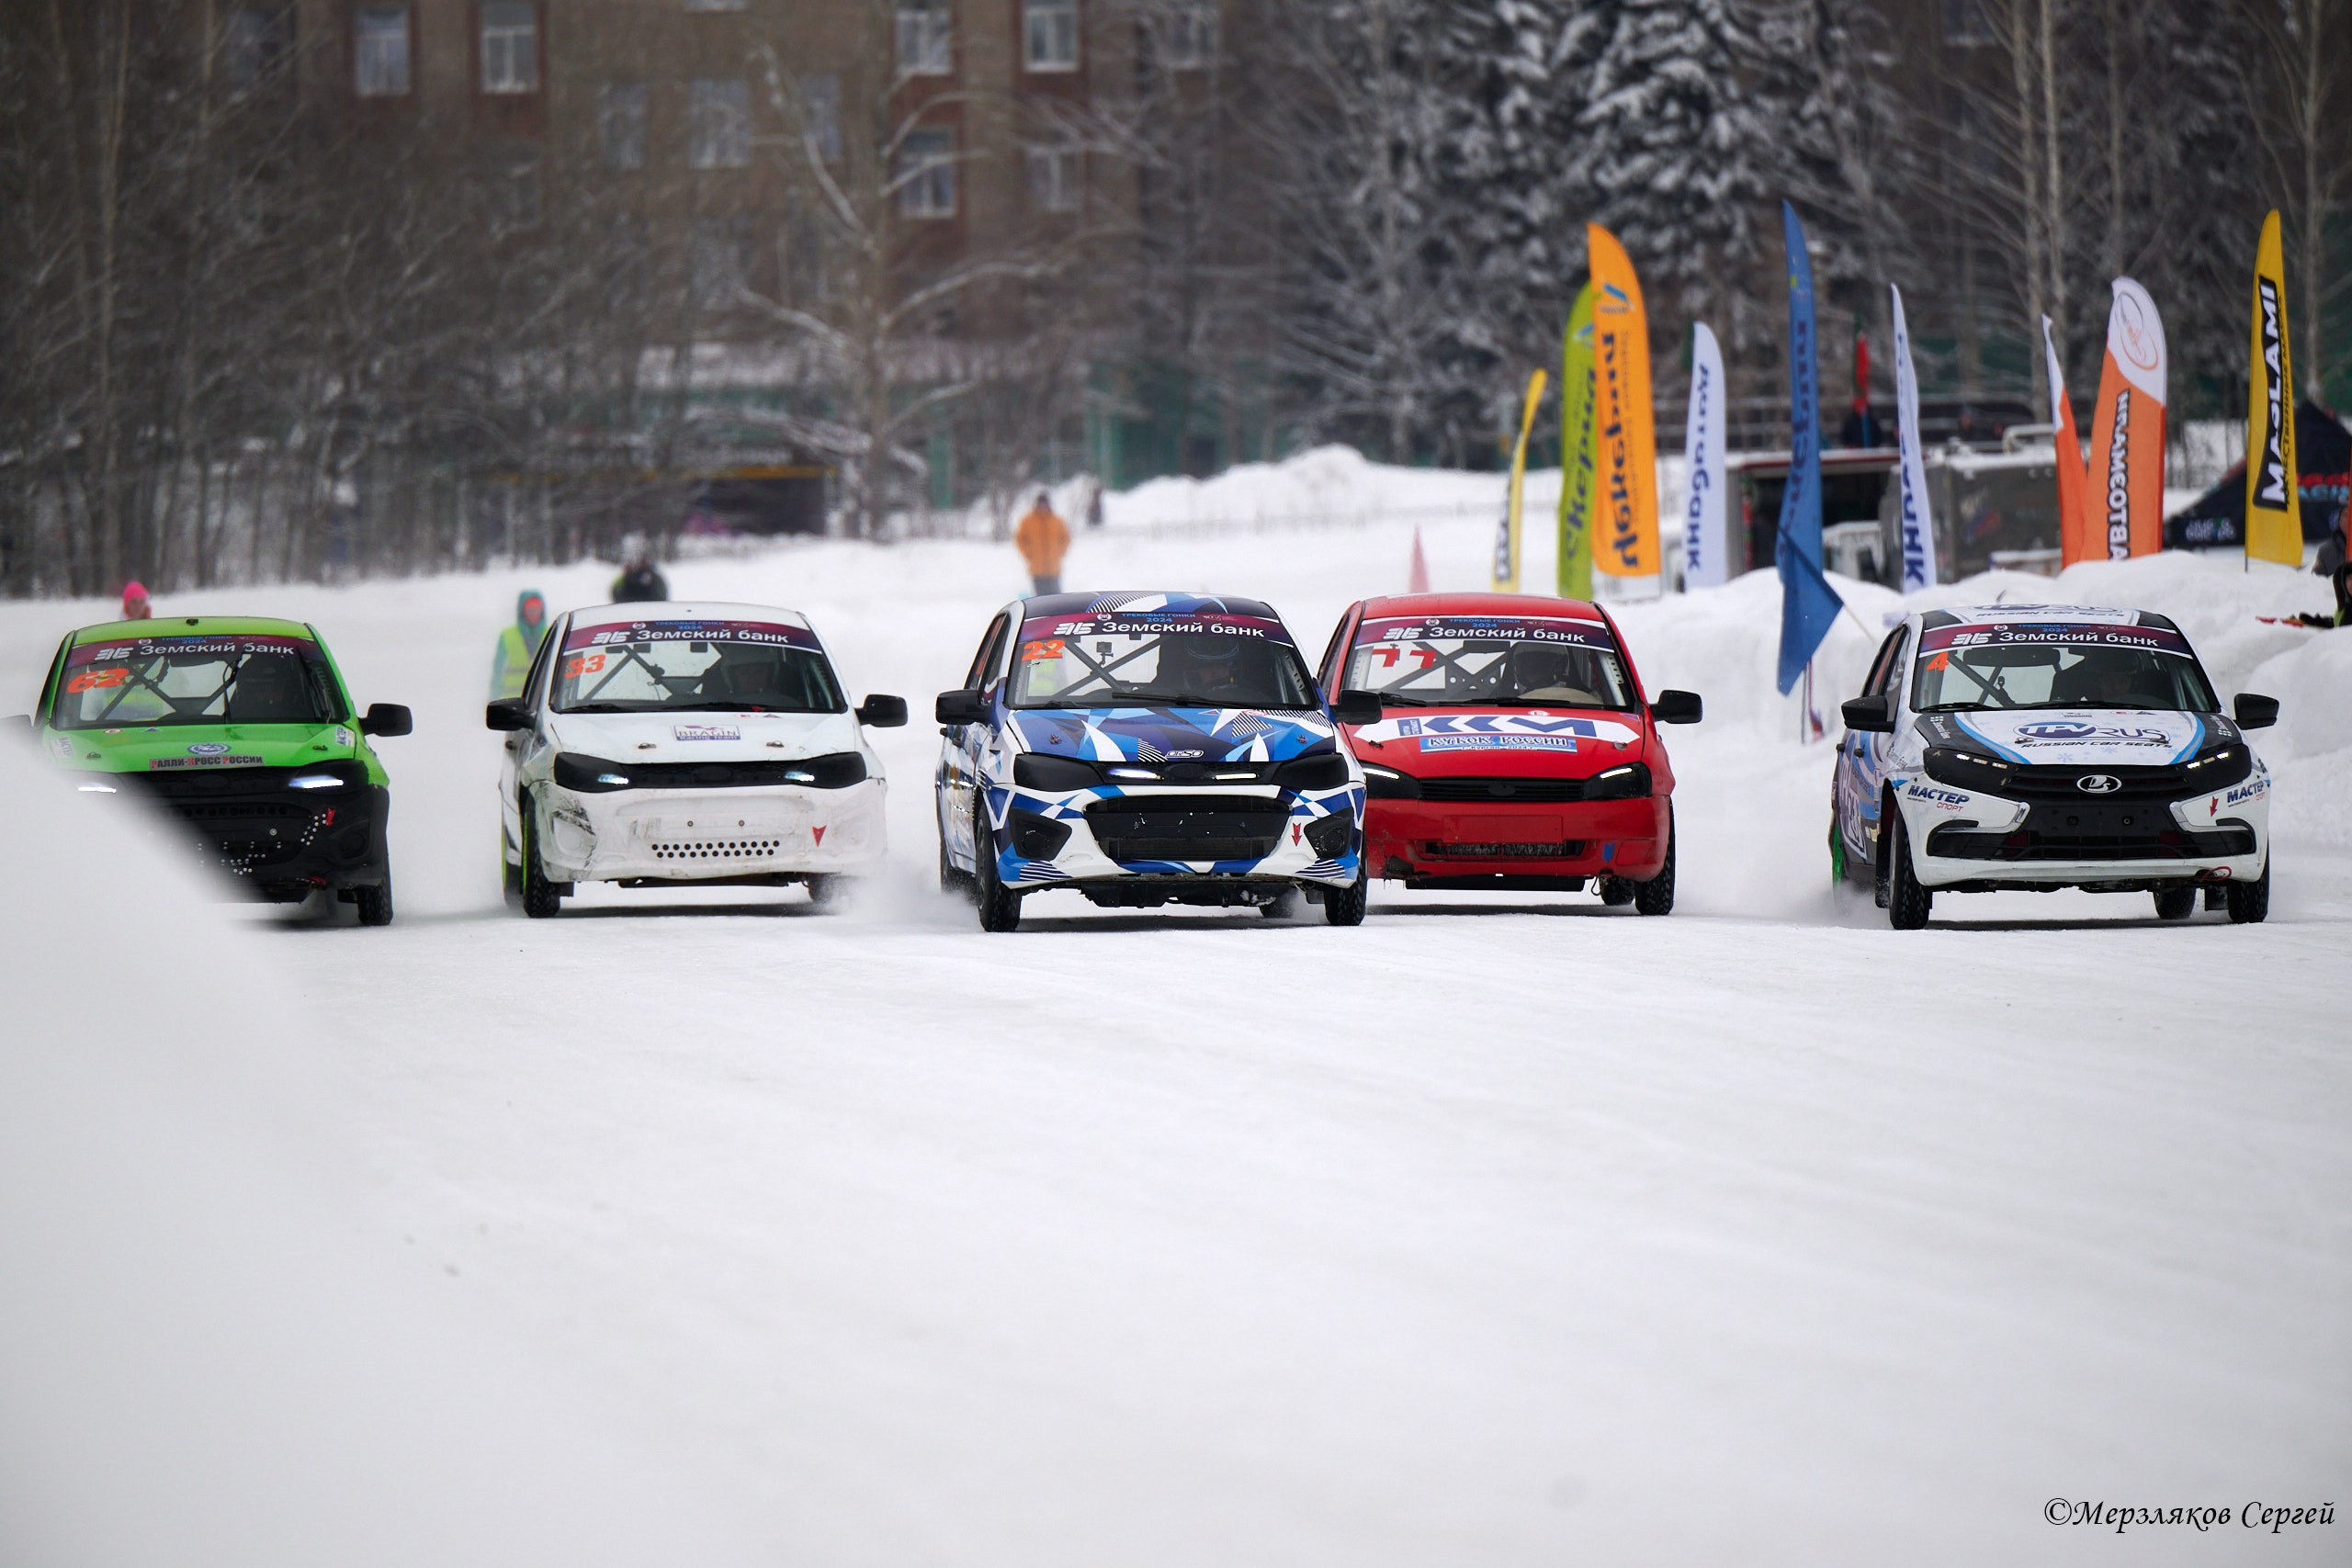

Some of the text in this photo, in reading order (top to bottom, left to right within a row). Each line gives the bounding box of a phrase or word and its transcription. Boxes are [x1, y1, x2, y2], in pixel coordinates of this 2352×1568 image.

[637, 628, 730, 640] Земский
[738, 629, 789, 643] банк
[1102, 621, 1203, 633] Земский
[1210, 623, 1265, 637] банк
[1429, 626, 1526, 637] Земский
[1532, 628, 1585, 643] банк
[1999, 631, 2098, 642] Земский
[2105, 632, 2158, 647] банк
[140, 641, 235, 656] Земский
[243, 642, 295, 655] банк
[1021, 639, 1066, 661] 22
[1372, 648, 1437, 669] 77
[1926, 651, 1949, 672] 4
[563, 654, 606, 680] 33
[66, 667, 130, 694] 62
[1429, 736, 1570, 748] КУБОК РОССИИ
[2096, 727, 2170, 742] RUS
[151, 755, 263, 771] РАЛЛИ-КРОСС РОССИИ
[1907, 784, 1971, 805] МАСТЕР
[2226, 780, 2265, 803] МАСТЕР
[1936, 801, 1964, 813] СПОРТ
